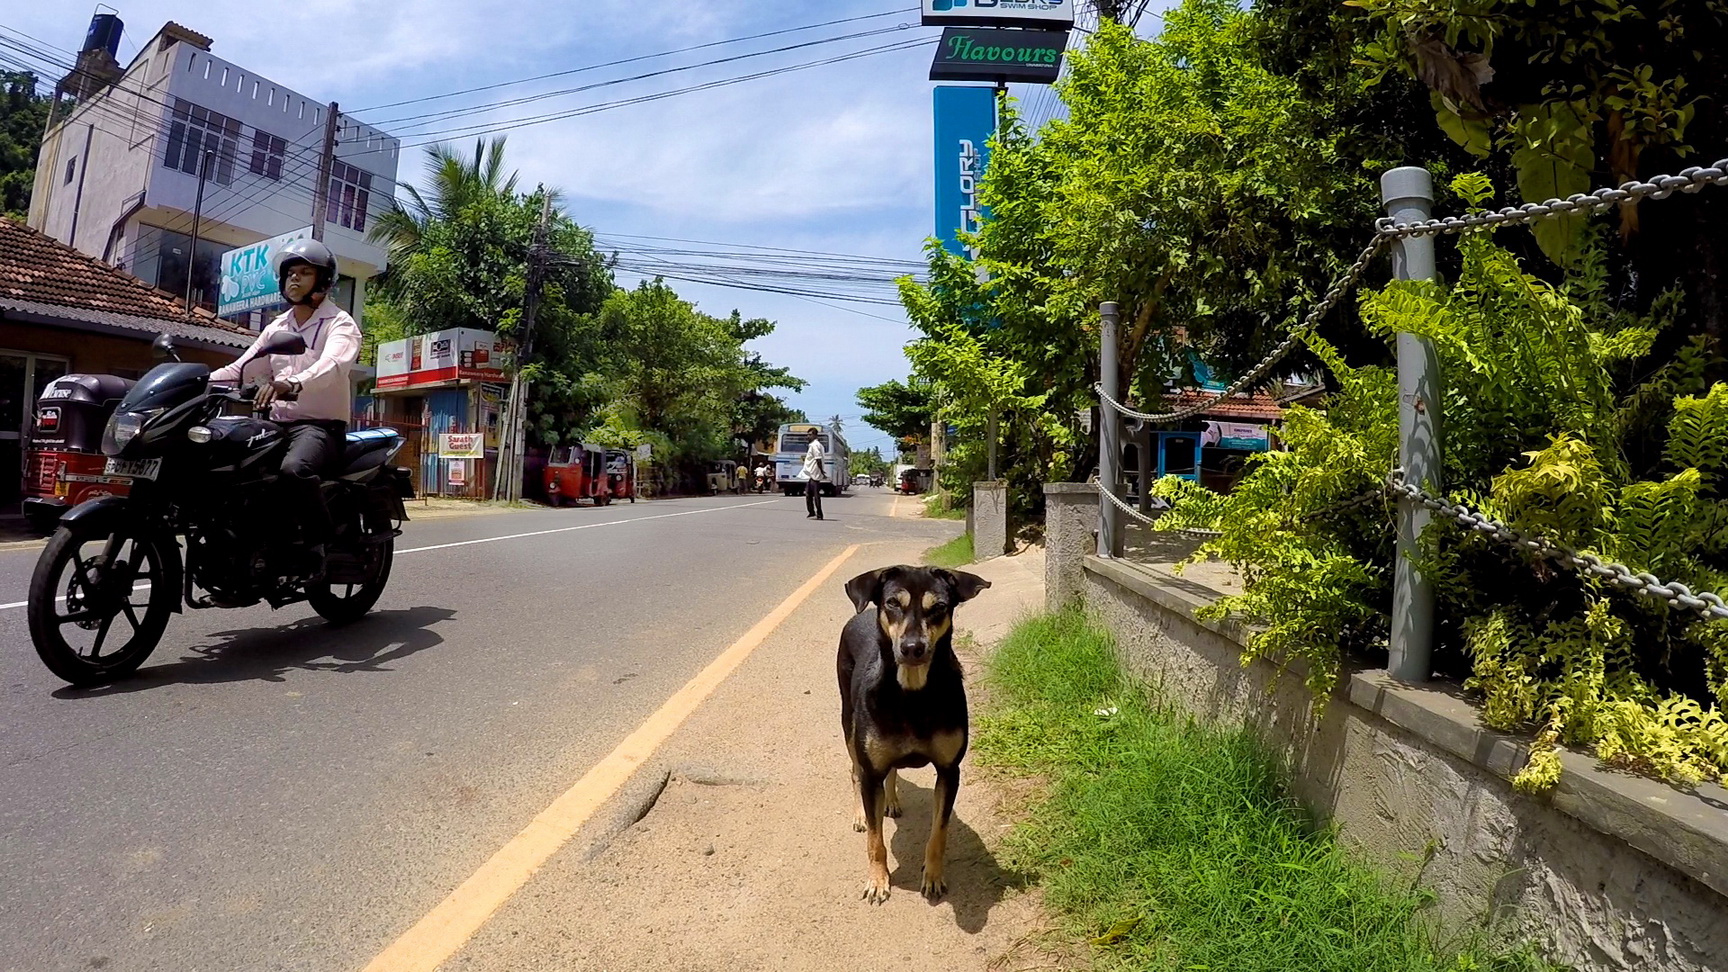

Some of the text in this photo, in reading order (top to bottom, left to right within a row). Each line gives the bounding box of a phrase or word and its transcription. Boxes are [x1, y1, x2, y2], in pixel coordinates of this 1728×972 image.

[945, 35, 1057, 62] Flavours
[959, 139, 983, 236] GLORY
[231, 244, 269, 278] KTK
[448, 435, 473, 443] Sarath
[449, 442, 472, 450] Guest
